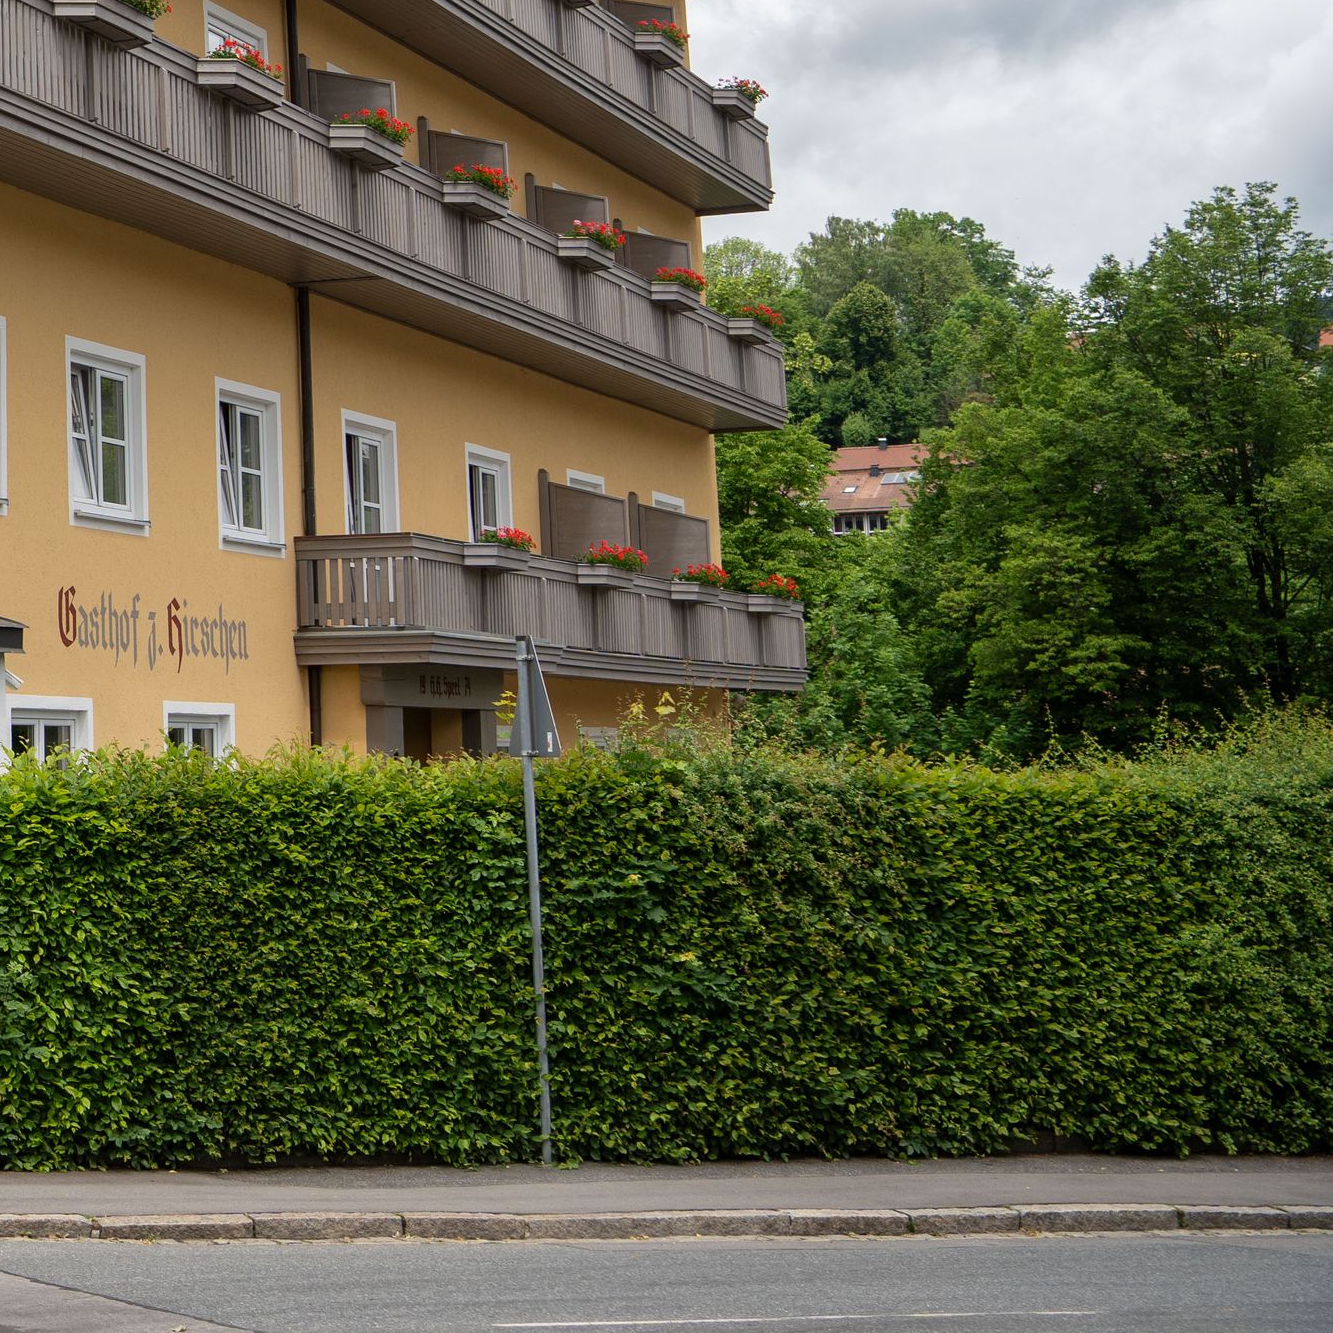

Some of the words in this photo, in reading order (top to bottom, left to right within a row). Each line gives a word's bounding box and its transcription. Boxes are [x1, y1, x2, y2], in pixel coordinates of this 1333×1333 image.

[58, 585, 141, 669] Gasthof
[147, 611, 164, 671] z.
[167, 597, 249, 676] Hirschen
